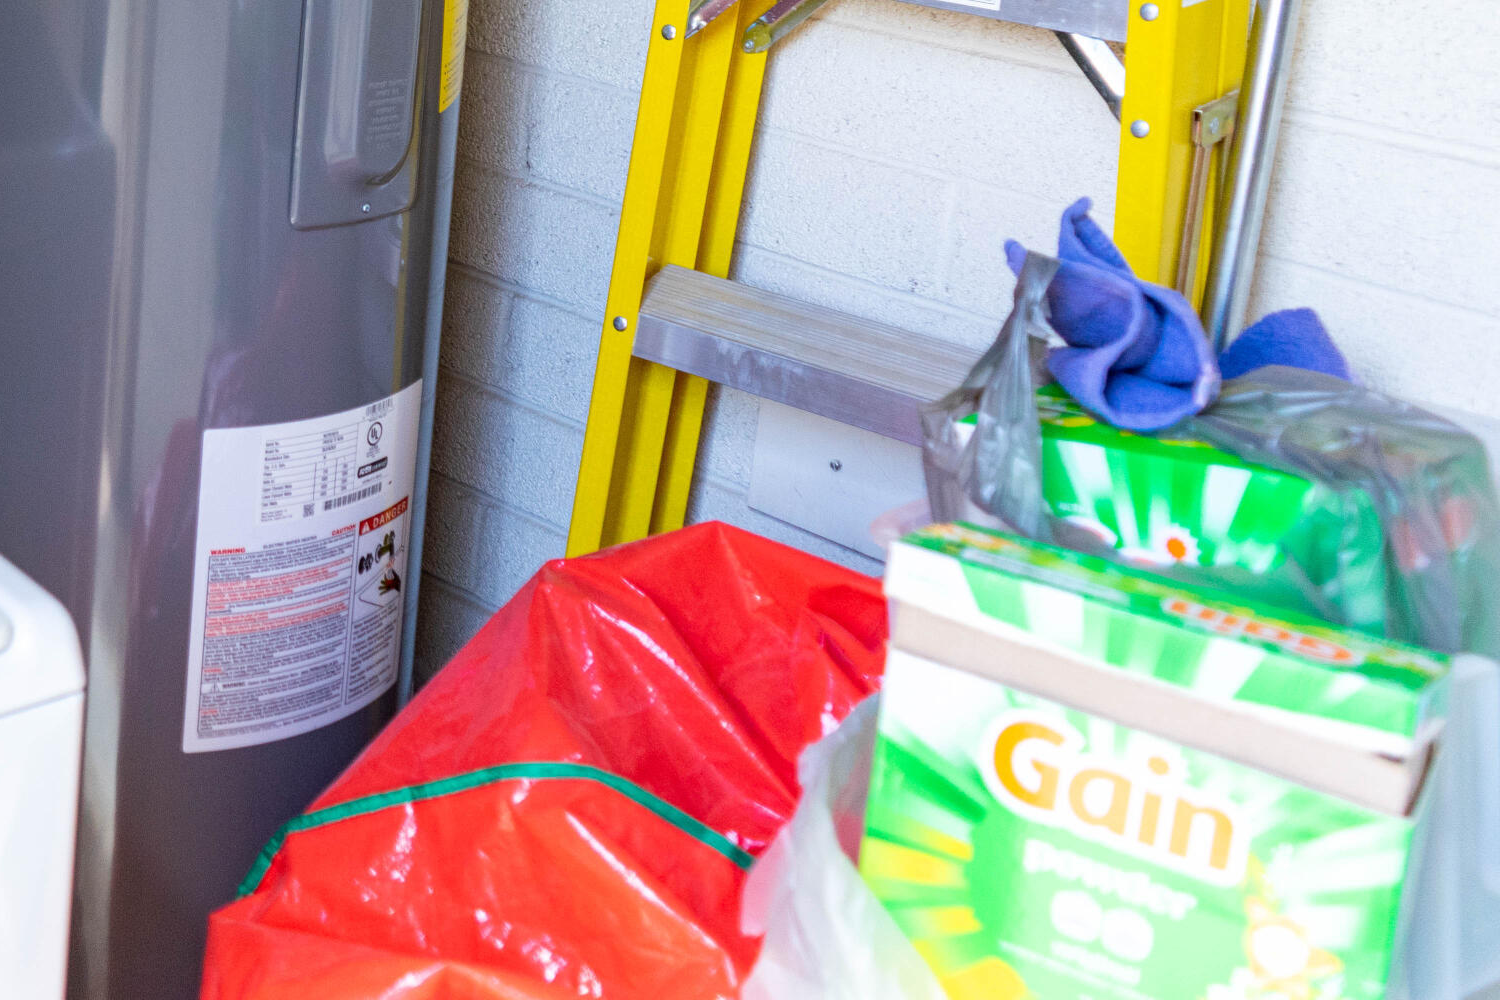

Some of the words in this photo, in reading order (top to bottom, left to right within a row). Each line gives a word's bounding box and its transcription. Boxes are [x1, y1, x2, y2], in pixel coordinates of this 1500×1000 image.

[372, 500, 407, 528] DANGER
[331, 523, 356, 536] CAUTION
[210, 547, 246, 555] WARNING
[992, 720, 1235, 872] Gain
